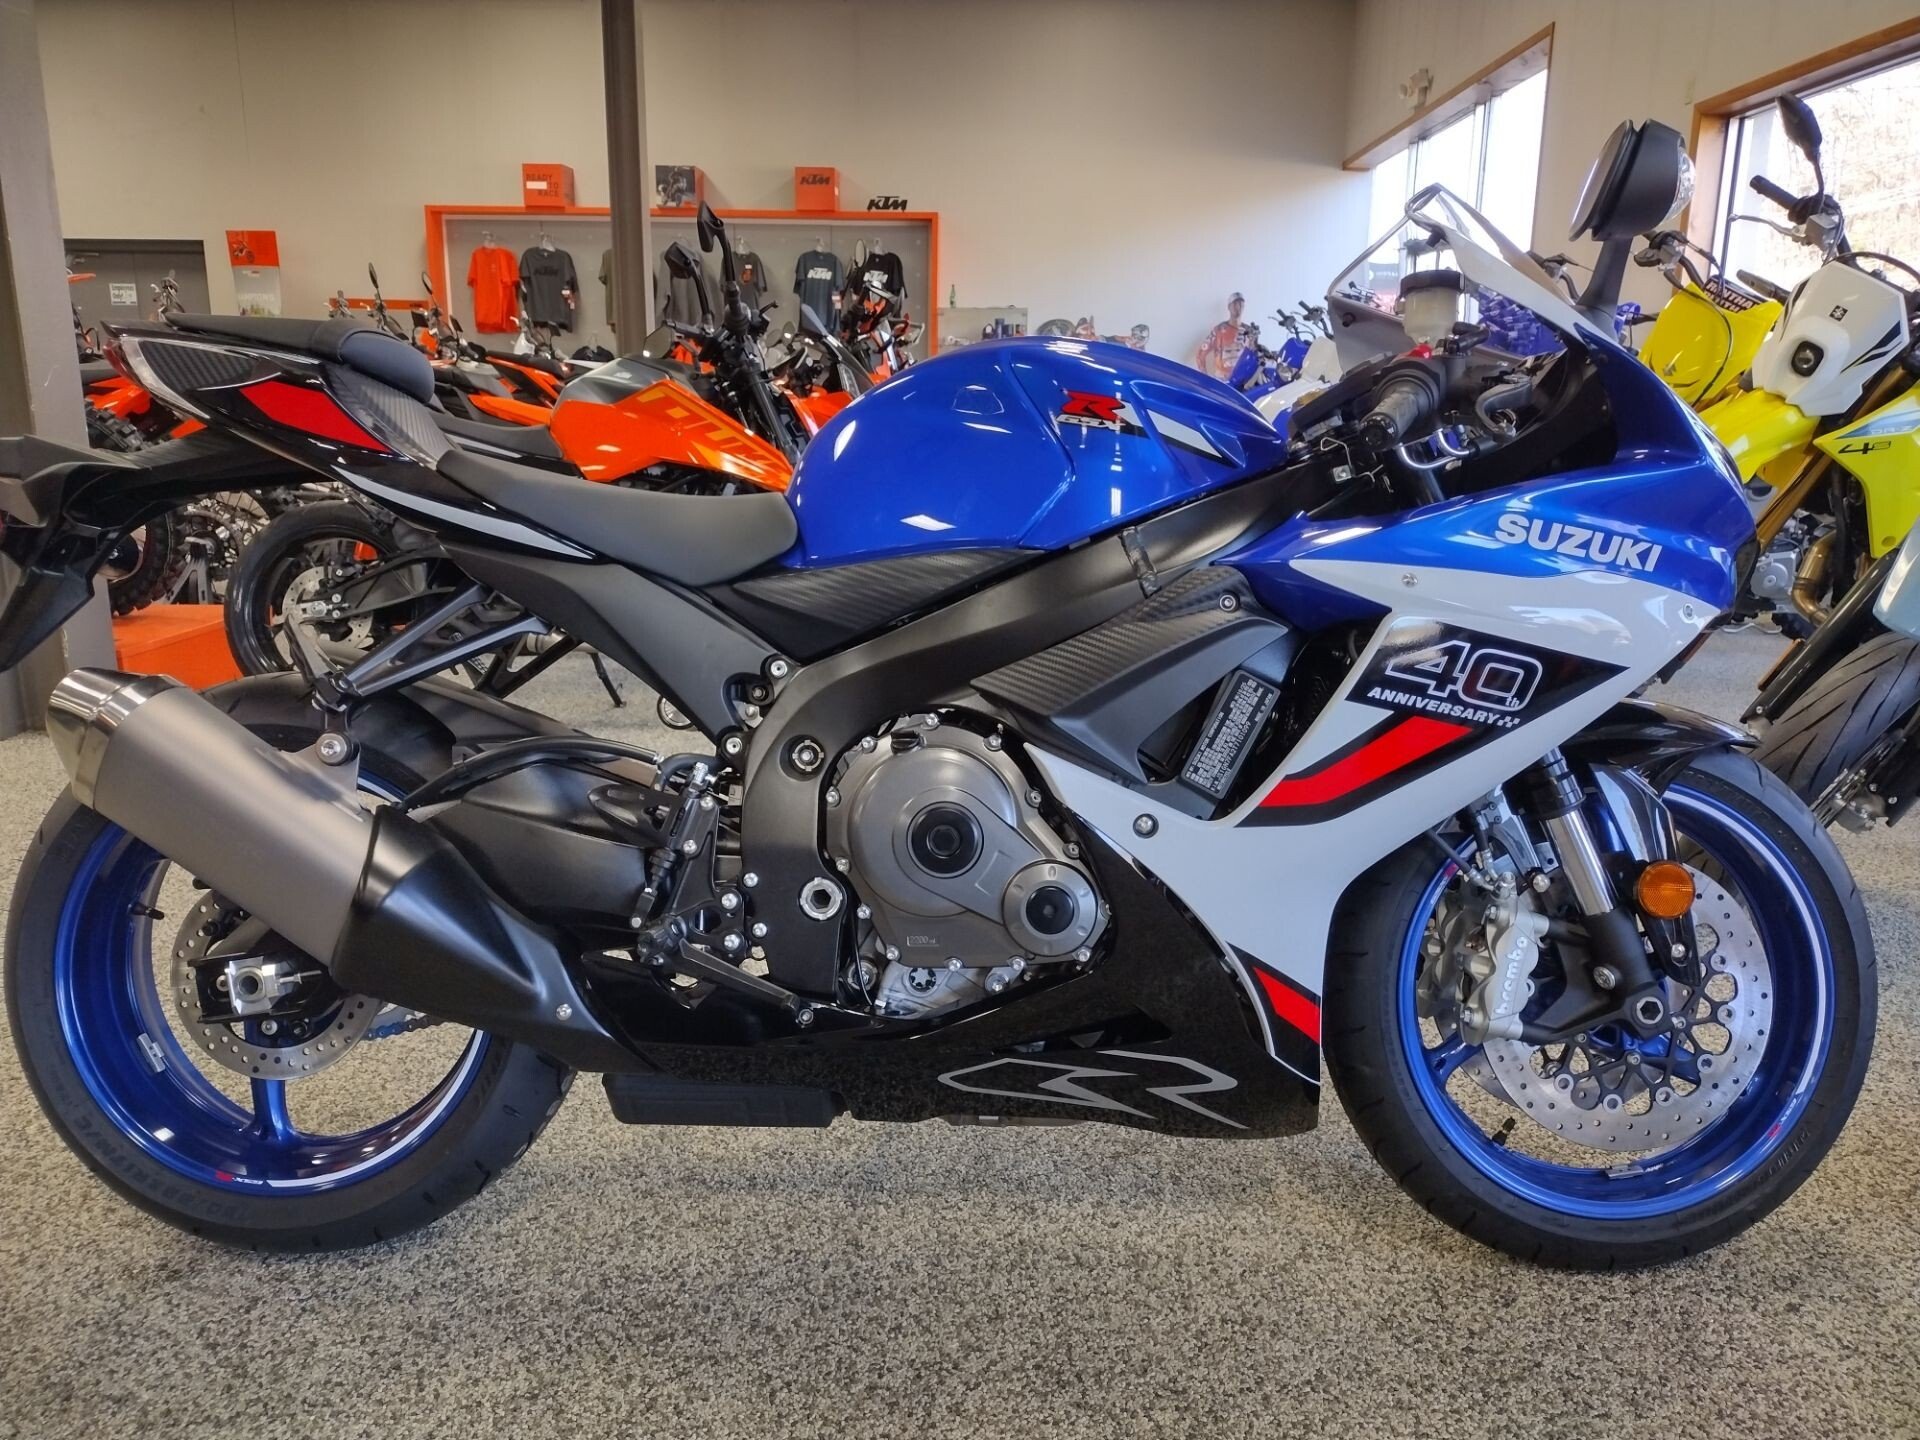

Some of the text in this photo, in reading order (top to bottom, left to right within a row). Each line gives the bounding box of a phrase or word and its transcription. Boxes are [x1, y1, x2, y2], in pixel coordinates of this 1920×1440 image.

[800, 174, 831, 185] KTM
[867, 196, 908, 211] KTM
[807, 267, 832, 280] KTM
[863, 270, 888, 283] KTM
[1494, 513, 1663, 572] SUZUKI
[1367, 686, 1501, 726] ANNIVERSARY
[1495, 936, 1528, 1015] brembo
